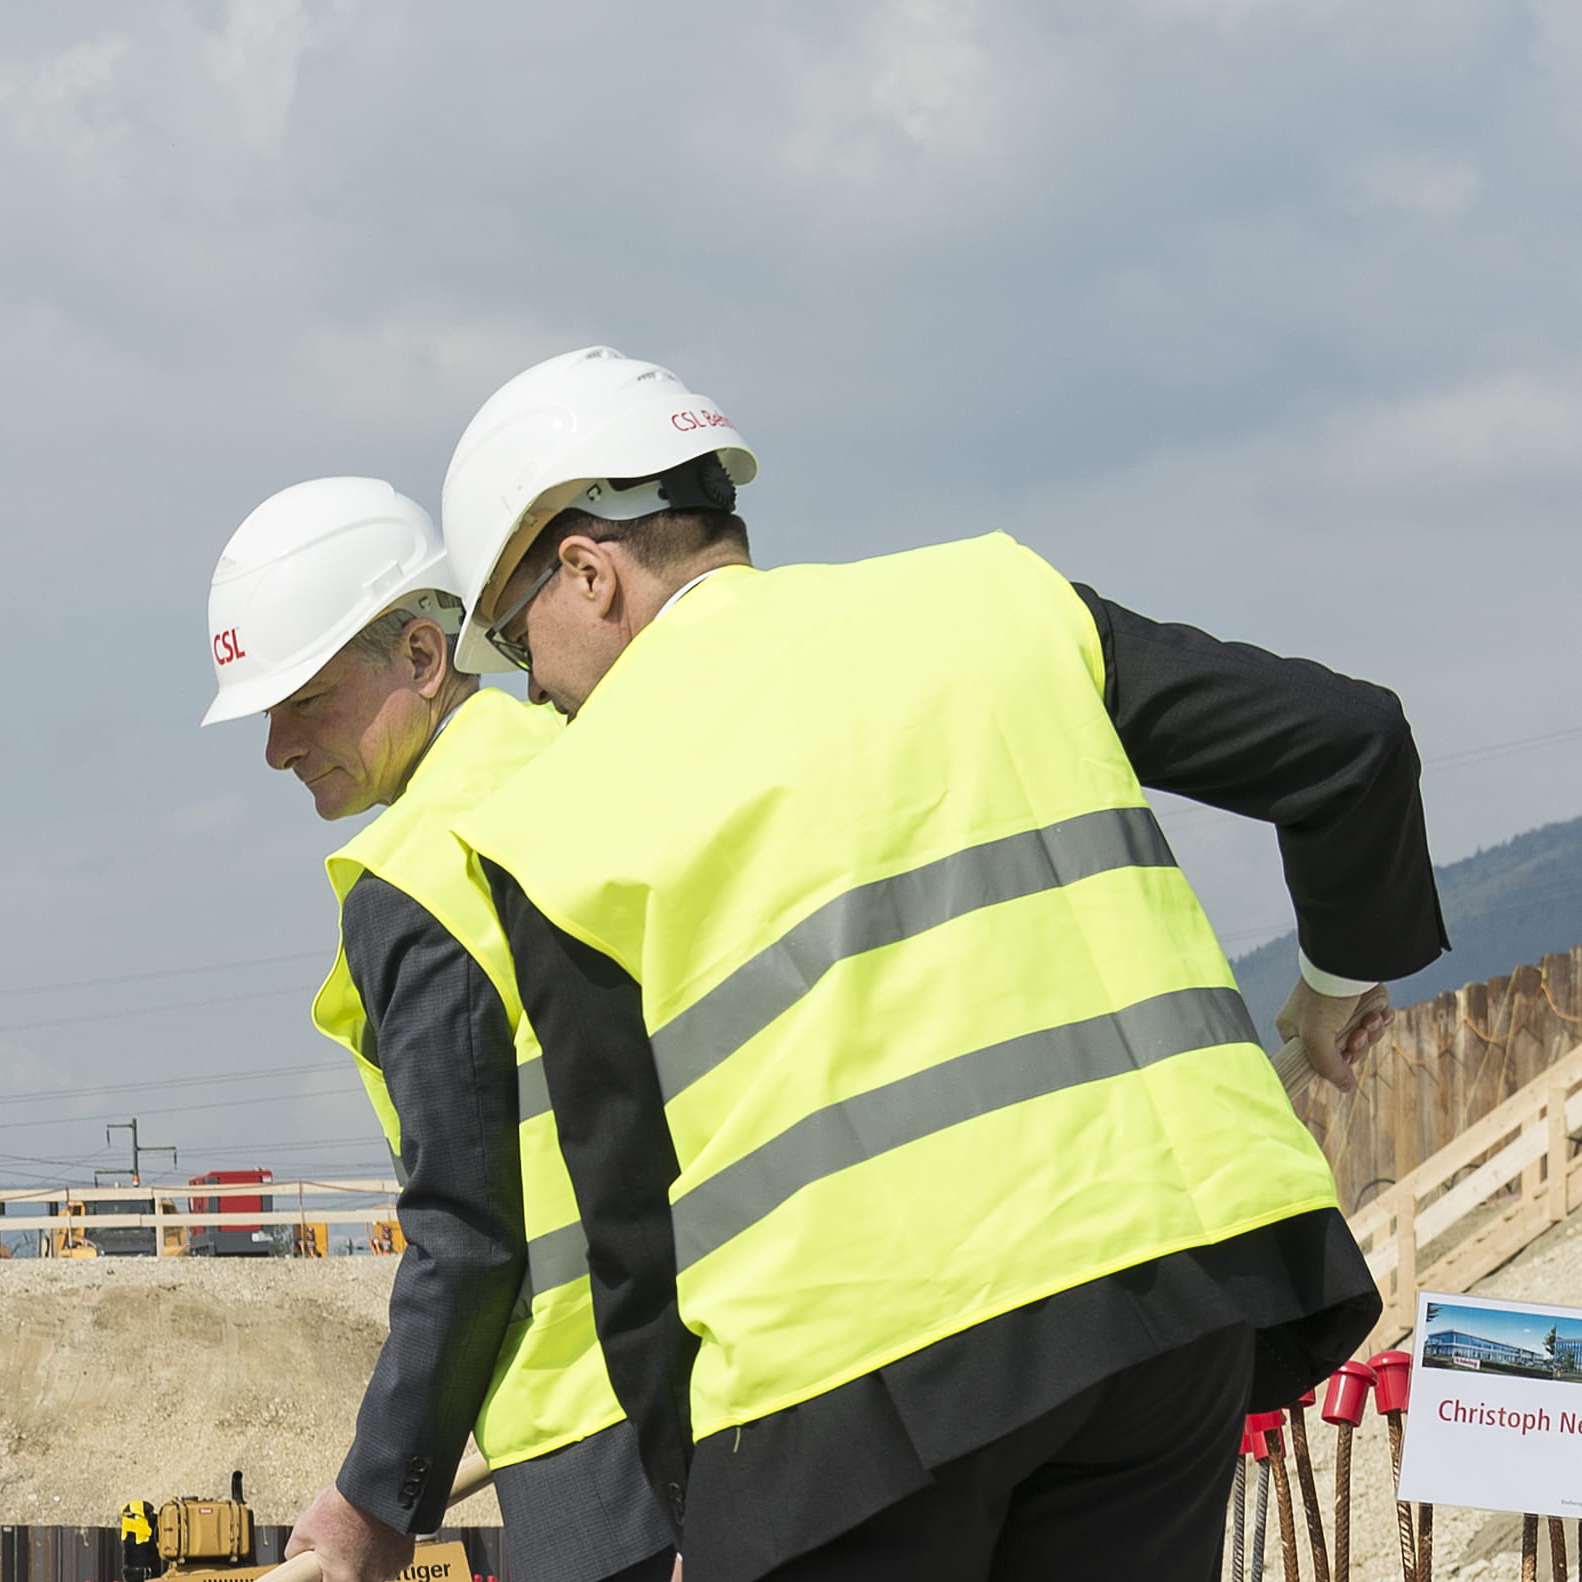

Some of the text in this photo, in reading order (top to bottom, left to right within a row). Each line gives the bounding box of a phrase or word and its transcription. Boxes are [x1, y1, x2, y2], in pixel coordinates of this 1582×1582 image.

[671, 411, 706, 431] CSL
[213, 628, 246, 666] CSL
[1438, 1399, 1550, 1435] Christoph
